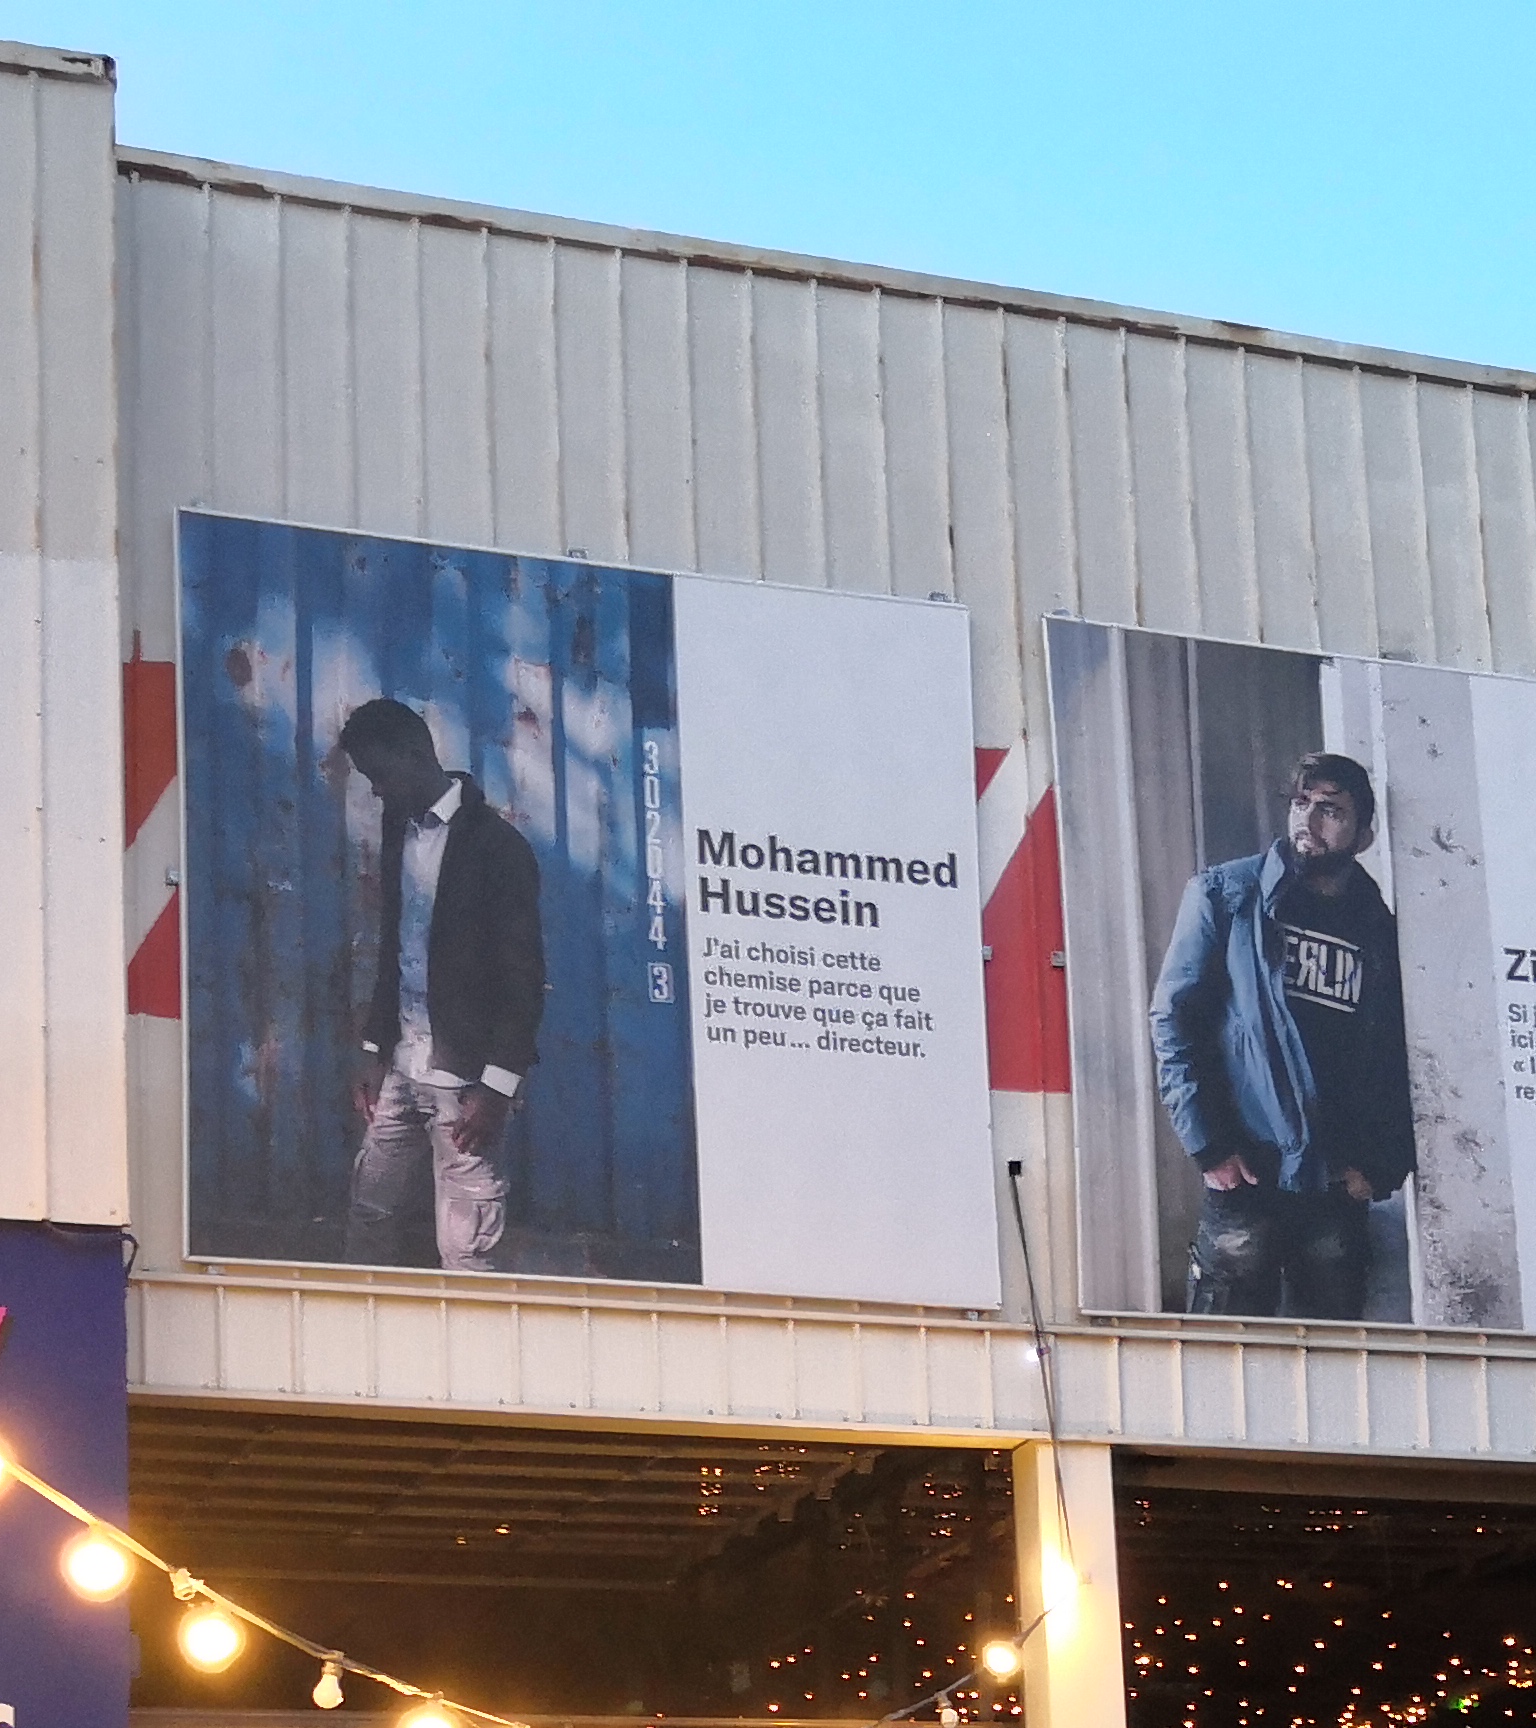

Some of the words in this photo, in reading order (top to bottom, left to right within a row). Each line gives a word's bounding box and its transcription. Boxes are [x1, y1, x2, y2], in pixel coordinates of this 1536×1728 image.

[697, 829, 957, 888] Mohammed
[699, 877, 879, 927] Hussein
[703, 937, 740, 960] J'ai
[747, 942, 814, 967] choisi
[822, 950, 881, 972] cette
[704, 967, 801, 993] chemise
[809, 976, 872, 999] parce
[879, 985, 921, 1003] que
[704, 993, 726, 1017] je
[732, 997, 806, 1022] trouve
[814, 1008, 854, 1026] que
[862, 1011, 889, 1031] ça
[894, 1009, 933, 1032] fait
[1508, 1003, 1527, 1023] Si
[707, 1027, 735, 1044] un
[818, 1031, 926, 1058] directeur.
